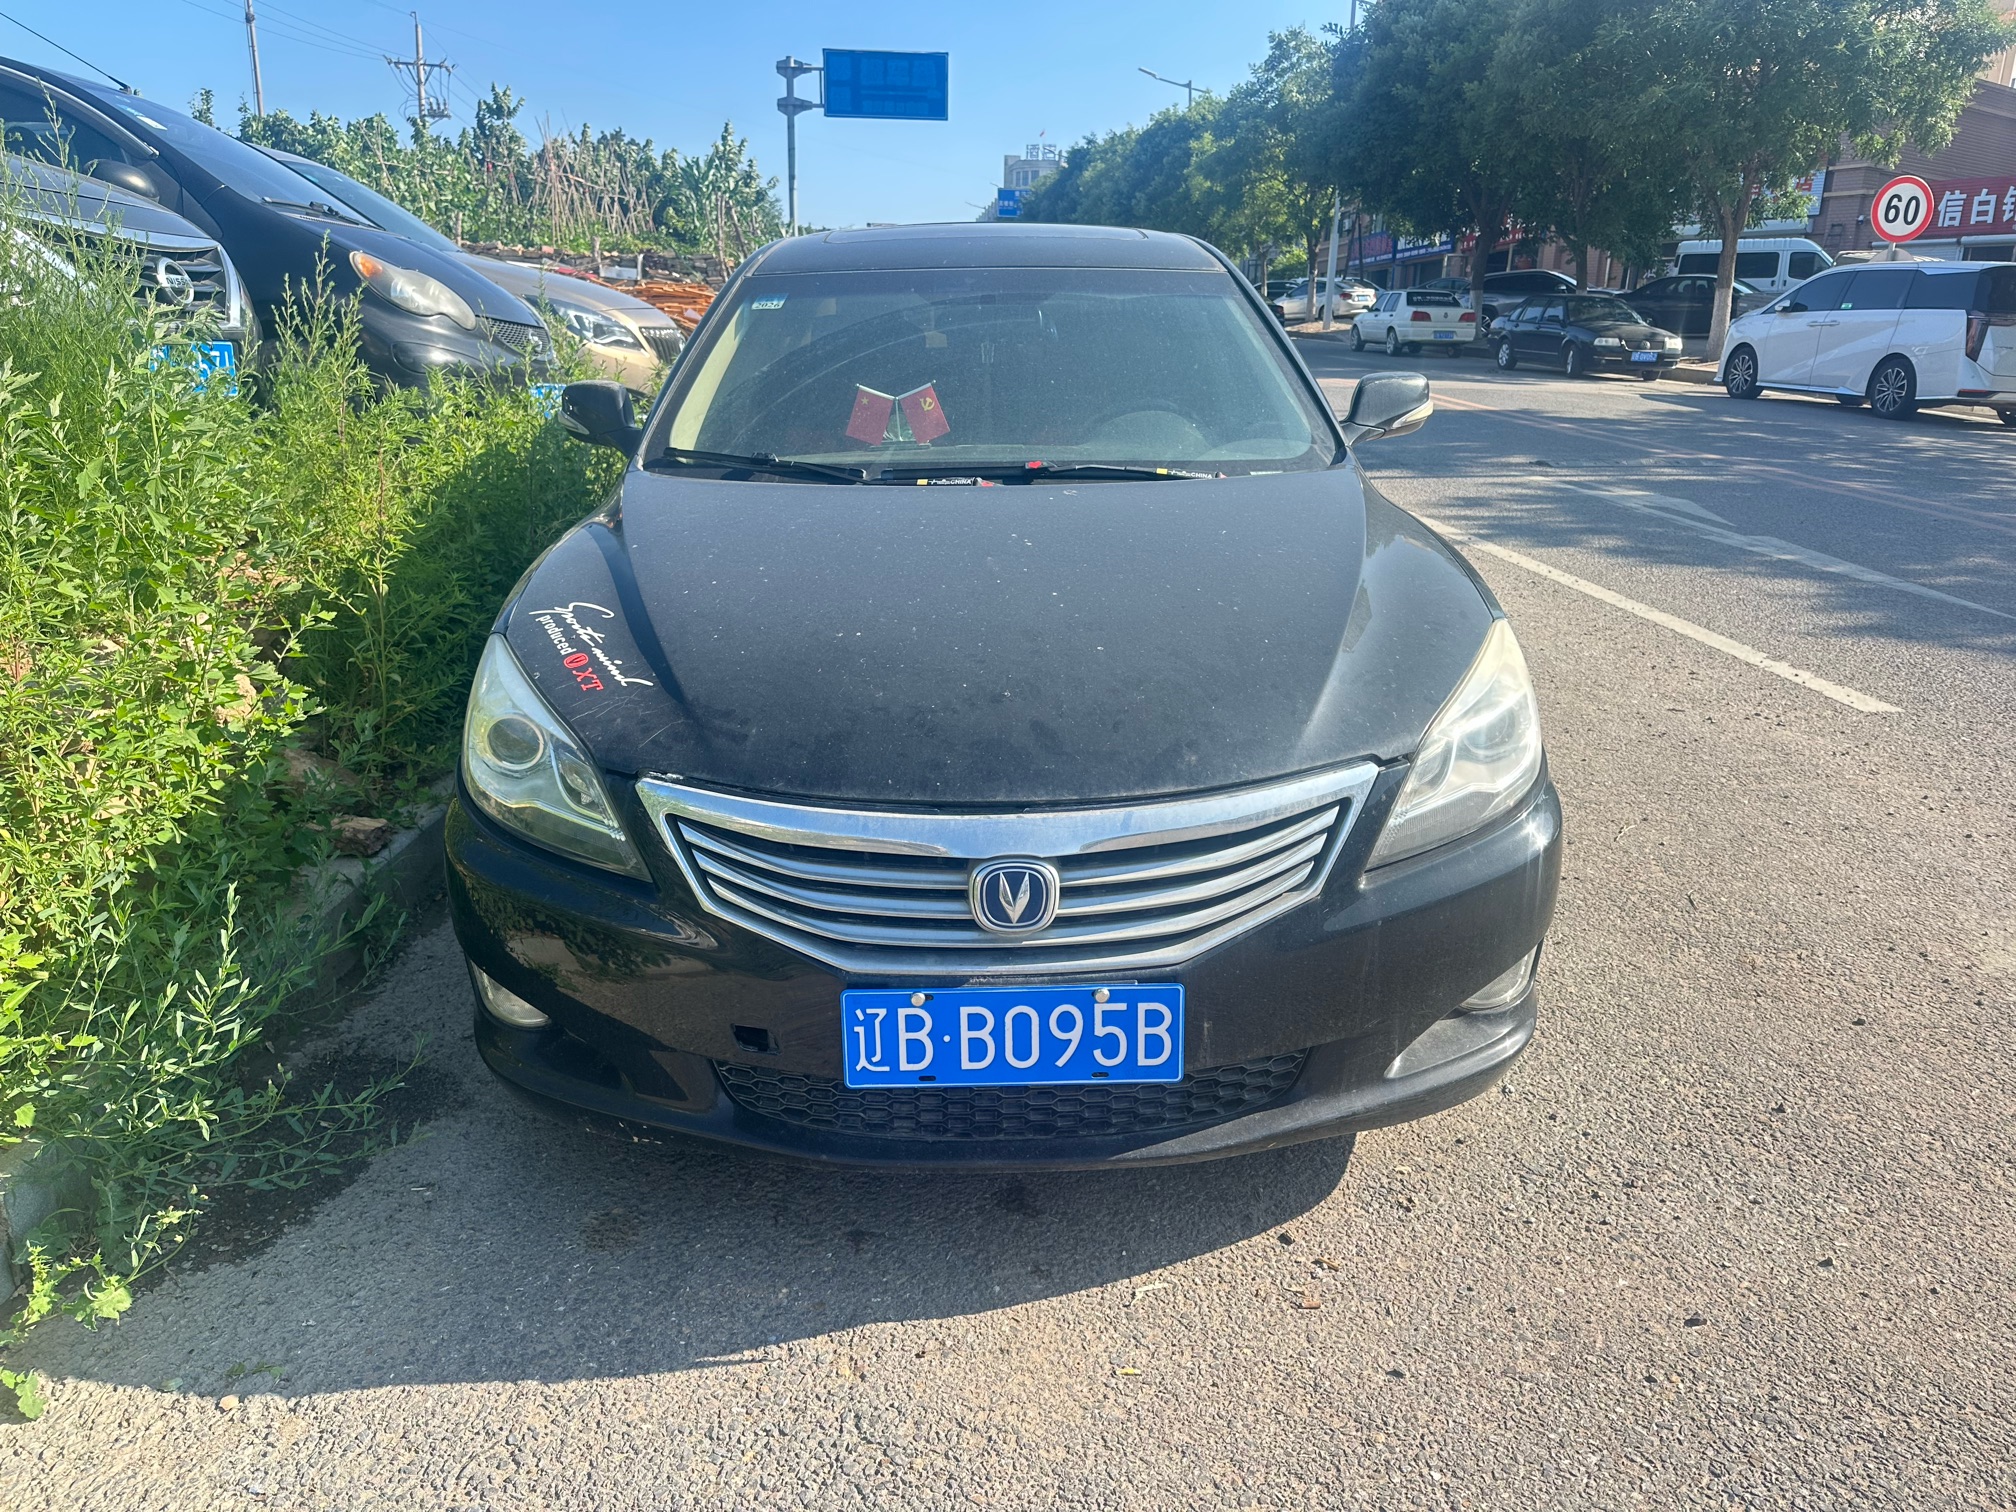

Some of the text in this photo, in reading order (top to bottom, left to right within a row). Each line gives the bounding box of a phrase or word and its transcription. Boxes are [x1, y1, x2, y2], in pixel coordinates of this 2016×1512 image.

[1884, 193, 1920, 226] 60
[535, 614, 578, 656] produced
[853, 1002, 1173, 1072] 辽B·B095B
